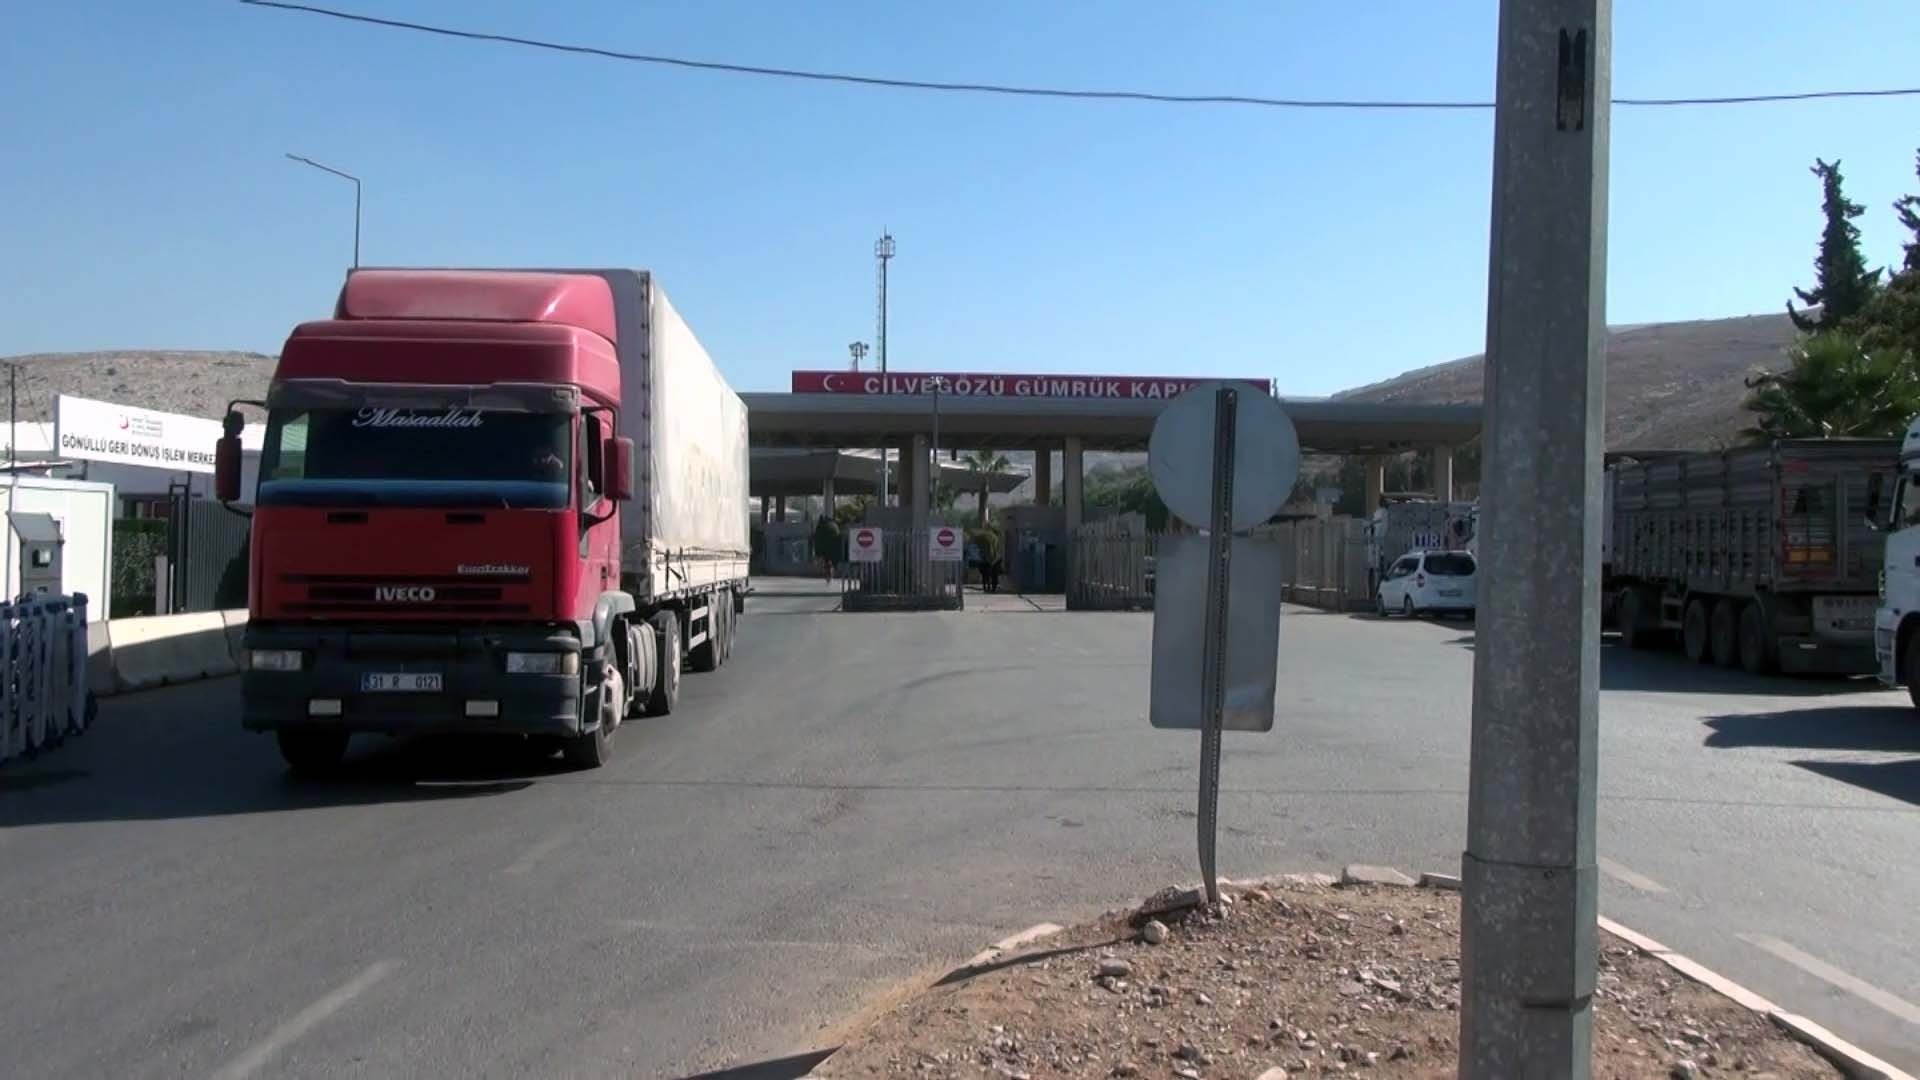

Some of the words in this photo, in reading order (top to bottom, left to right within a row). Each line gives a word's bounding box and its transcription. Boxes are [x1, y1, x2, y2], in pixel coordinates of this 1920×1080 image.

[1015, 376, 1121, 398] GÜMRÜK
[375, 586, 435, 601] IVECO
[369, 674, 383, 688] 31
[416, 675, 439, 688] 0121
